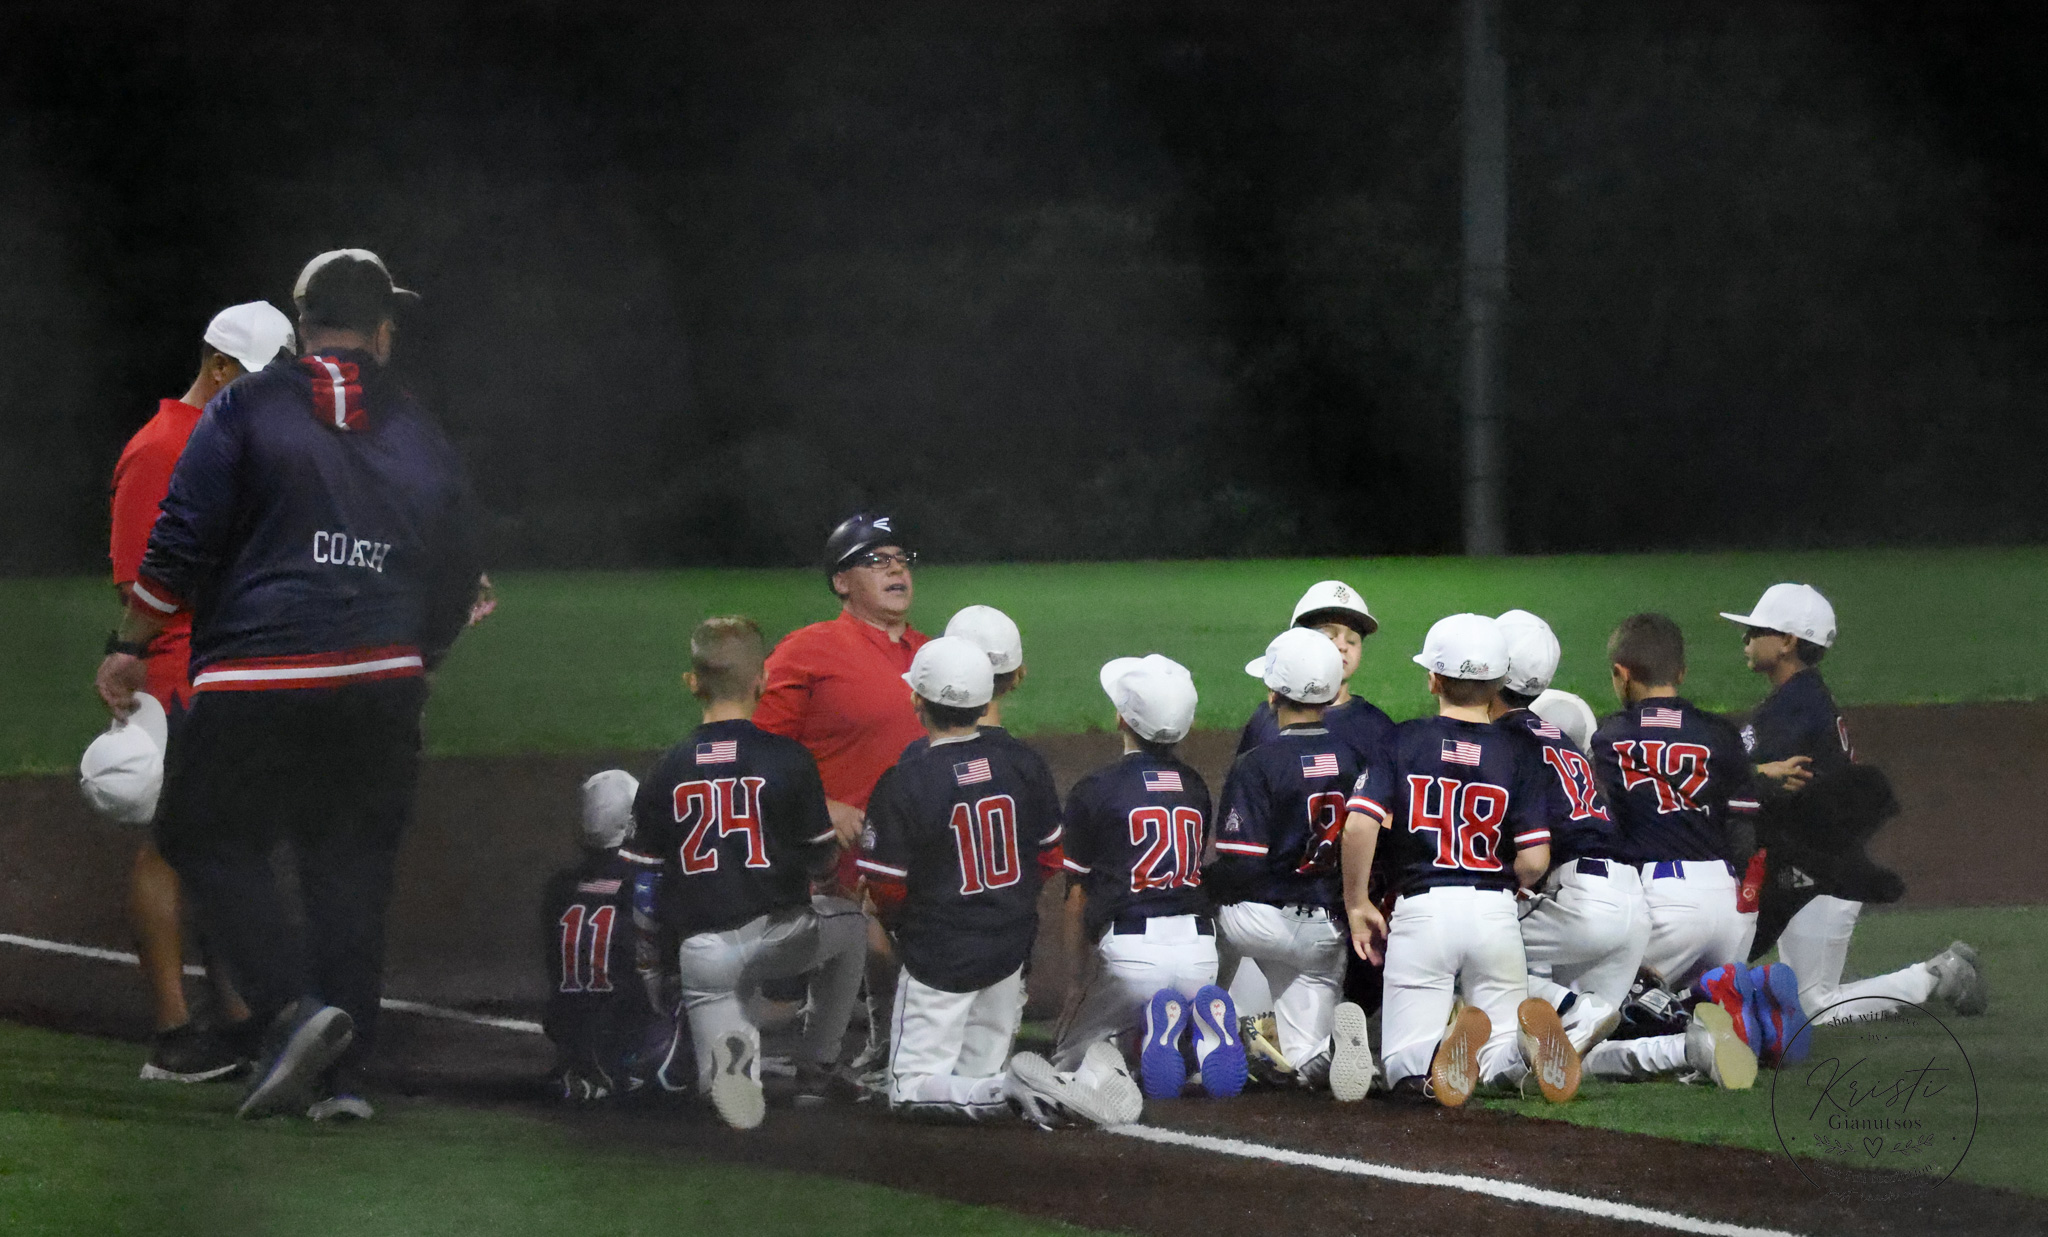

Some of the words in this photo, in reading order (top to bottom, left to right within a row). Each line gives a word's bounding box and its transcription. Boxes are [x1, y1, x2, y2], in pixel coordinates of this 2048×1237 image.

[1406, 774, 1509, 872] 48
[1612, 740, 1711, 815] 42
[673, 776, 771, 875] 24
[949, 794, 1021, 896] 10
[1128, 806, 1203, 893] 20
[559, 904, 616, 992] 11
